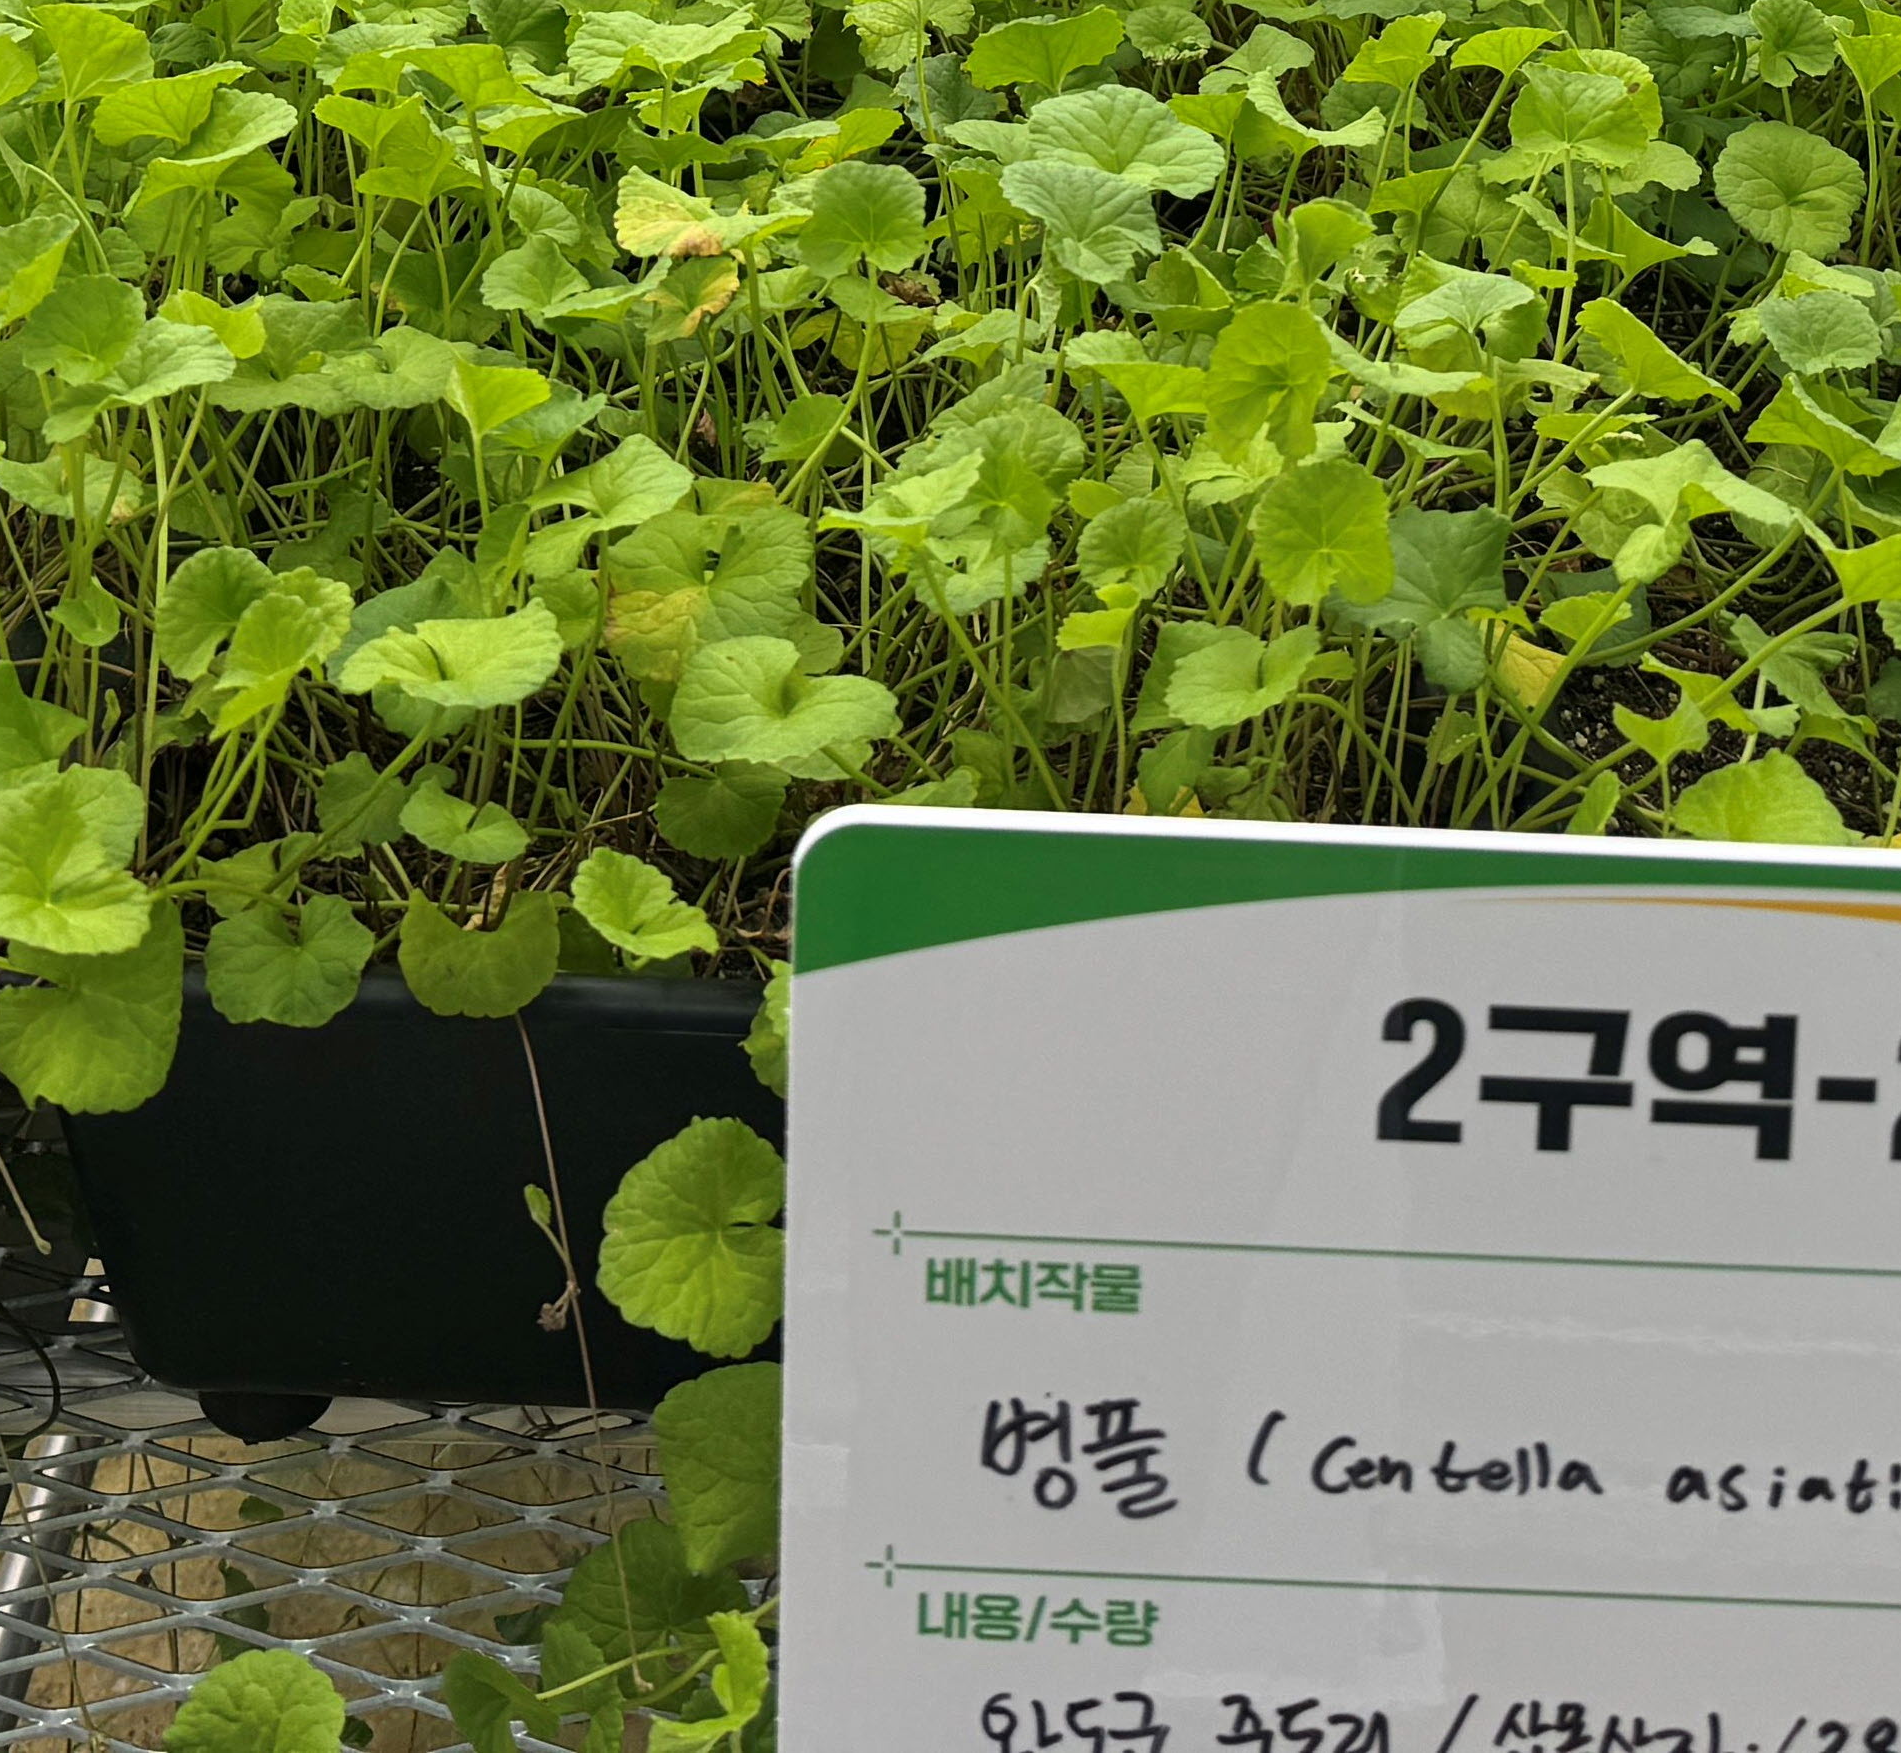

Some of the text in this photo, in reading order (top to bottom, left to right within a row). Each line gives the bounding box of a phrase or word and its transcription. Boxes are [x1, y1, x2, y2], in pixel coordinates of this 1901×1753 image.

[924, 1257, 1143, 1317] 배치작물
[979, 1394, 1179, 1521] 병풀
[916, 1592, 1160, 1650] 내용/수량
